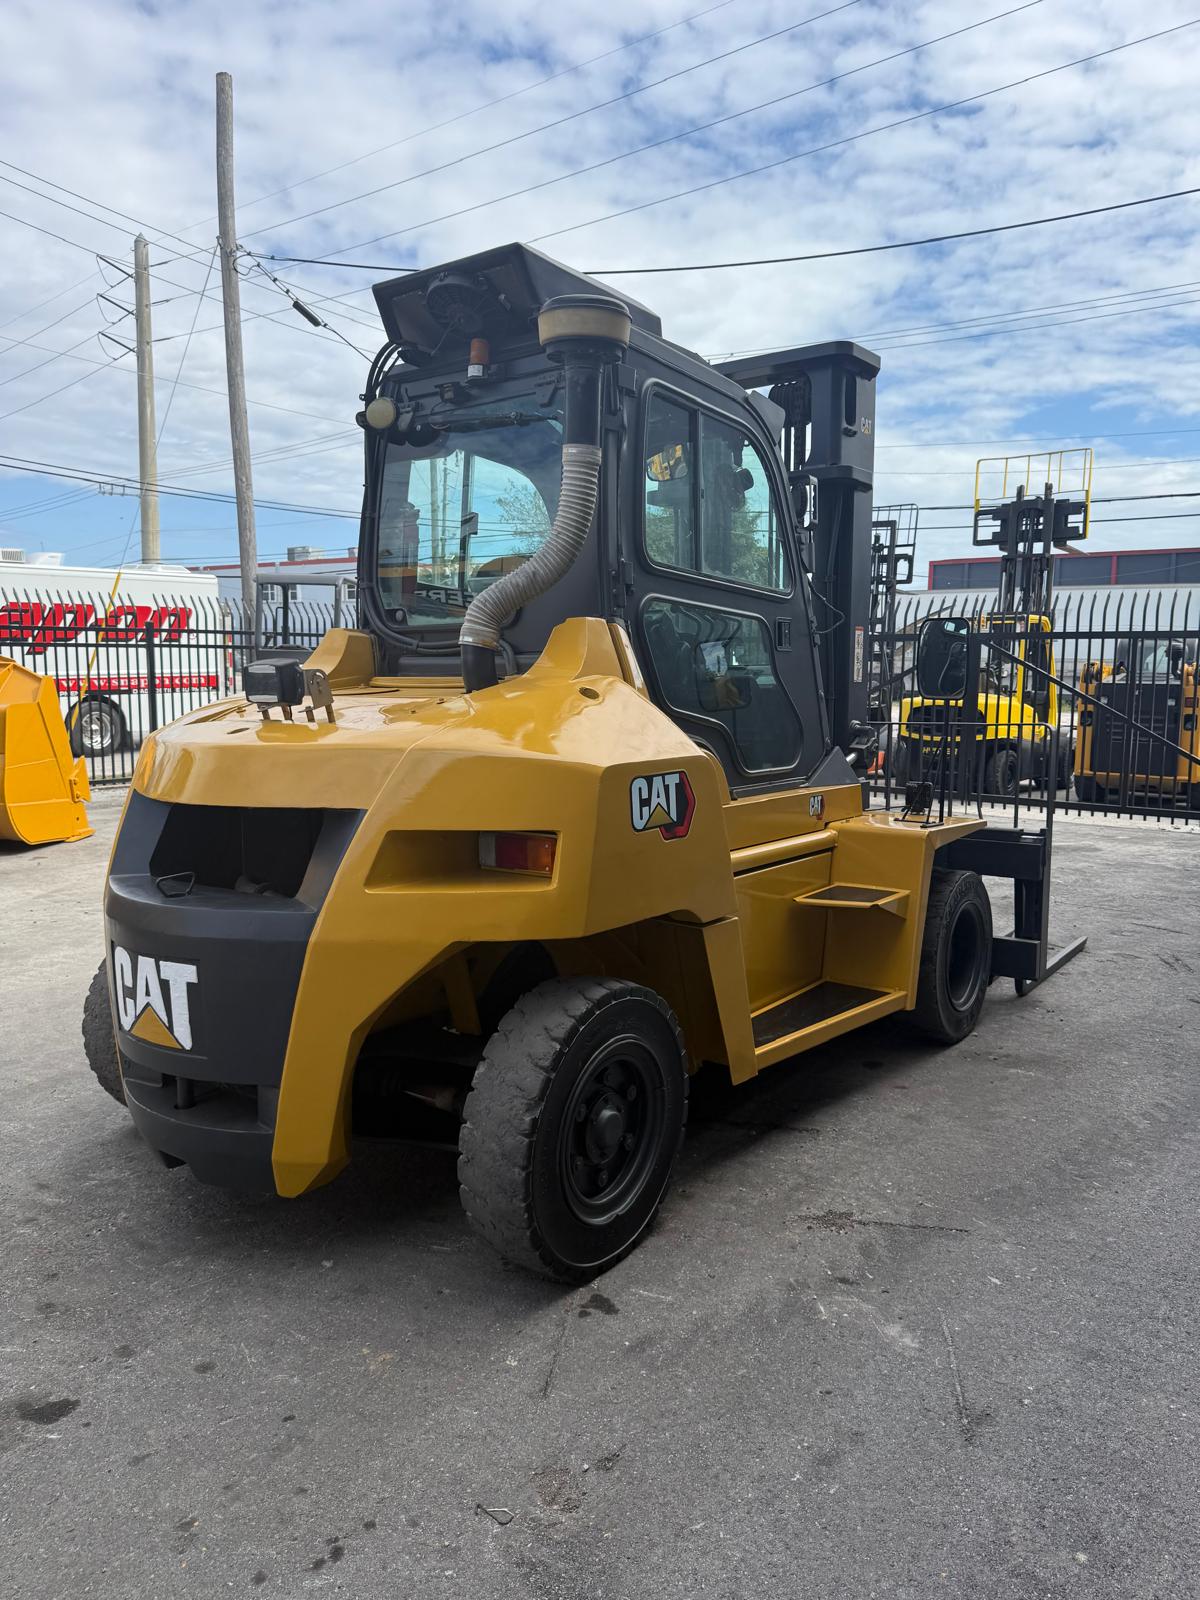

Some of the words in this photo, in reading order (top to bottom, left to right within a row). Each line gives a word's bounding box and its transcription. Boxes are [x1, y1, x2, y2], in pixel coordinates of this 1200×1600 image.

[860, 417, 872, 435] CAT
[60, 676, 206, 688] www.snapncom
[632, 773, 680, 830] CAT
[810, 795, 822, 816] CAT
[114, 946, 198, 1050] CAT
